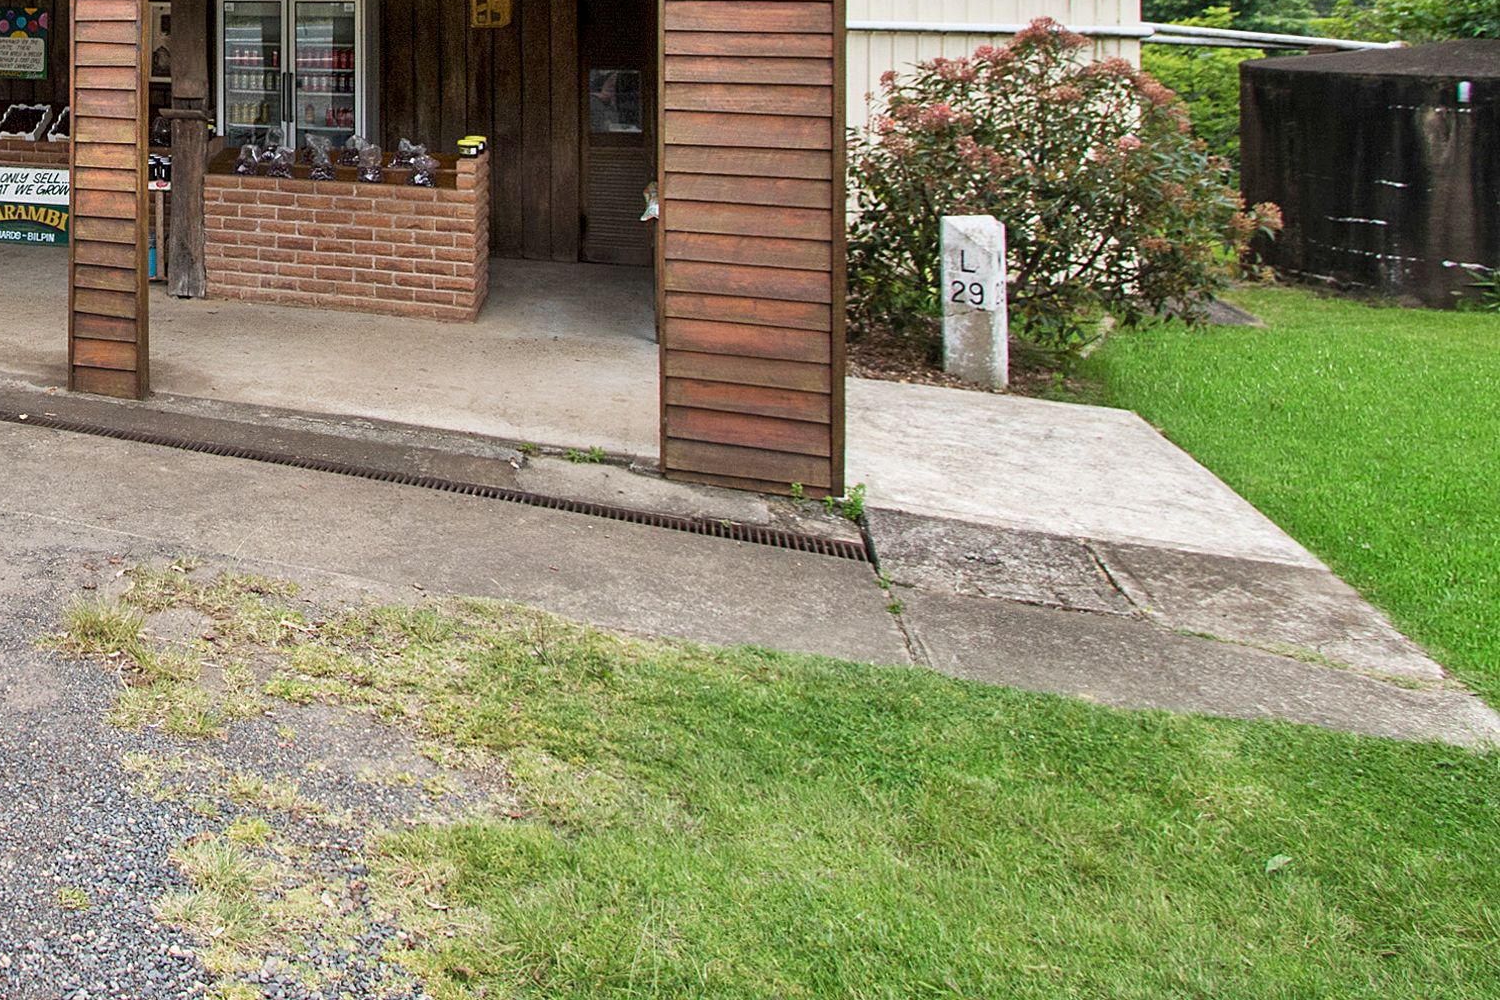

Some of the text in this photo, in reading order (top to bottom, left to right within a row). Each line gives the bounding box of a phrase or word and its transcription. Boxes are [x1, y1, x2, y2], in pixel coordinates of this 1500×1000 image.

[0, 172, 30, 184] ONLY
[14, 184, 34, 195] WE
[36, 184, 69, 195] GROW
[27, 231, 55, 243] BILPIN
[960, 249, 976, 274] L
[950, 280, 984, 305] 29
